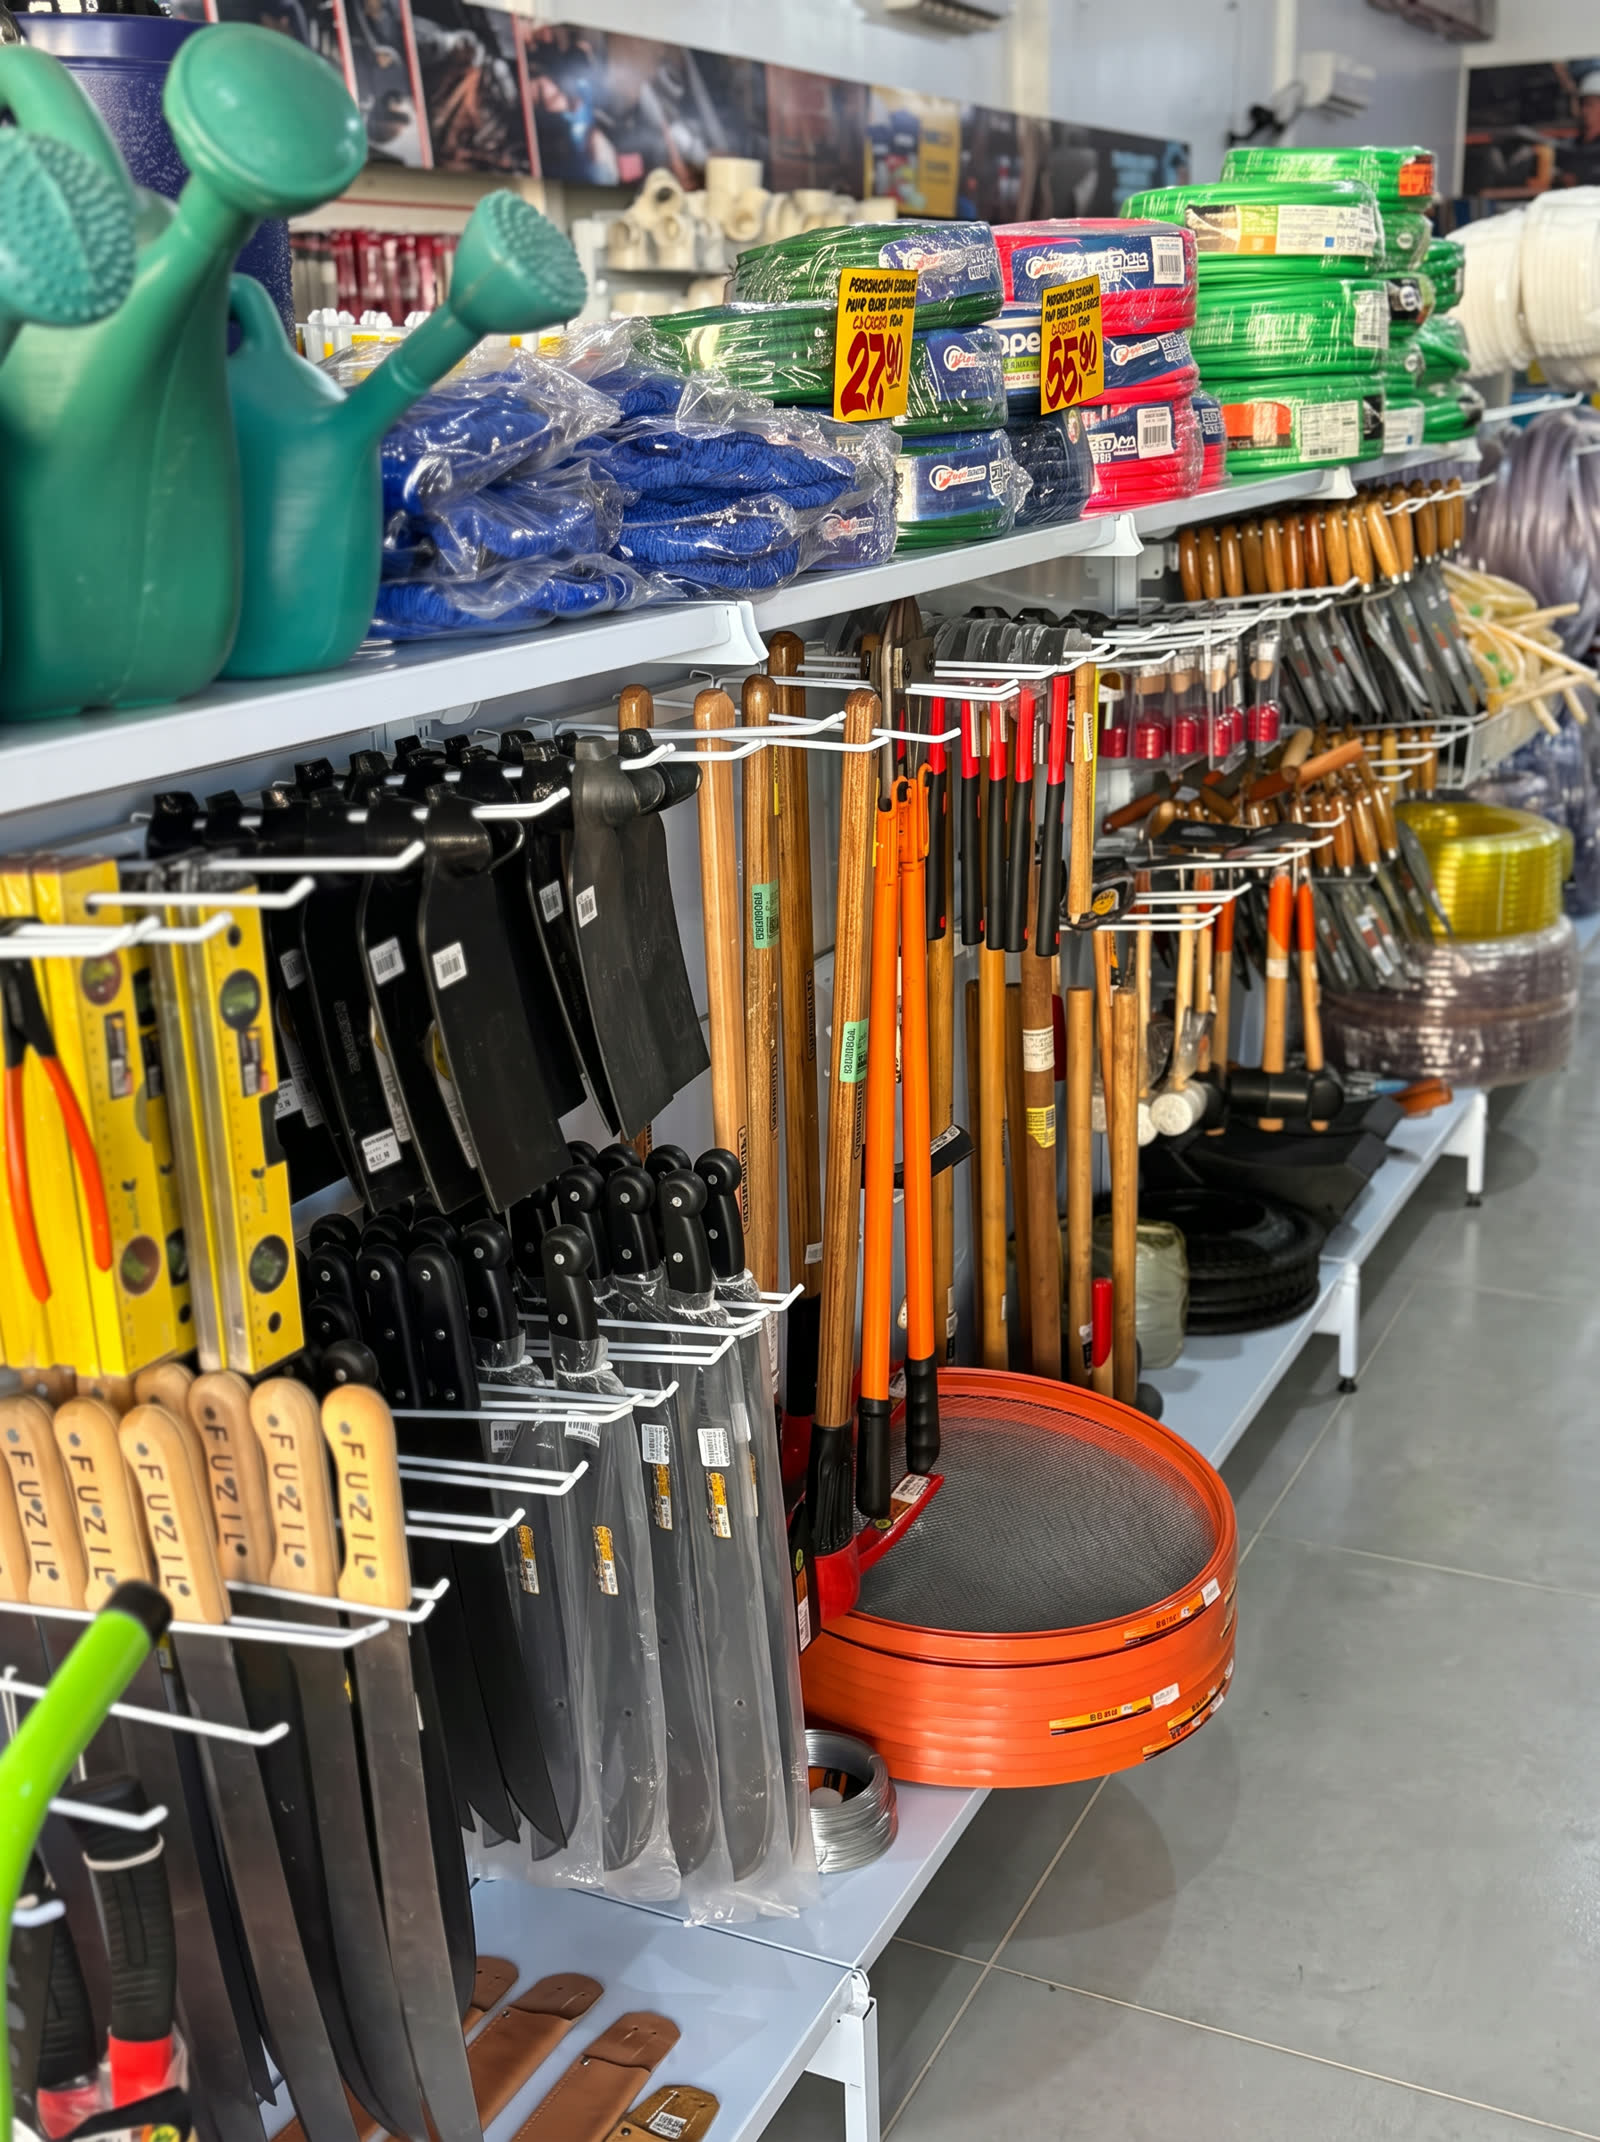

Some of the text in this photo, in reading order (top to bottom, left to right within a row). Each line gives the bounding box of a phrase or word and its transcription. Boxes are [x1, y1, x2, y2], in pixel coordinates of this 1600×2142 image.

[10, 1450, 56, 1574] FUZIL
[69, 1455, 116, 1580] FUZIL
[138, 1464, 188, 1588] FUZIL
[204, 1424, 246, 1545] FUZIL
[269, 1432, 307, 1556] FUZIL
[341, 1441, 378, 1567] FUZIL
